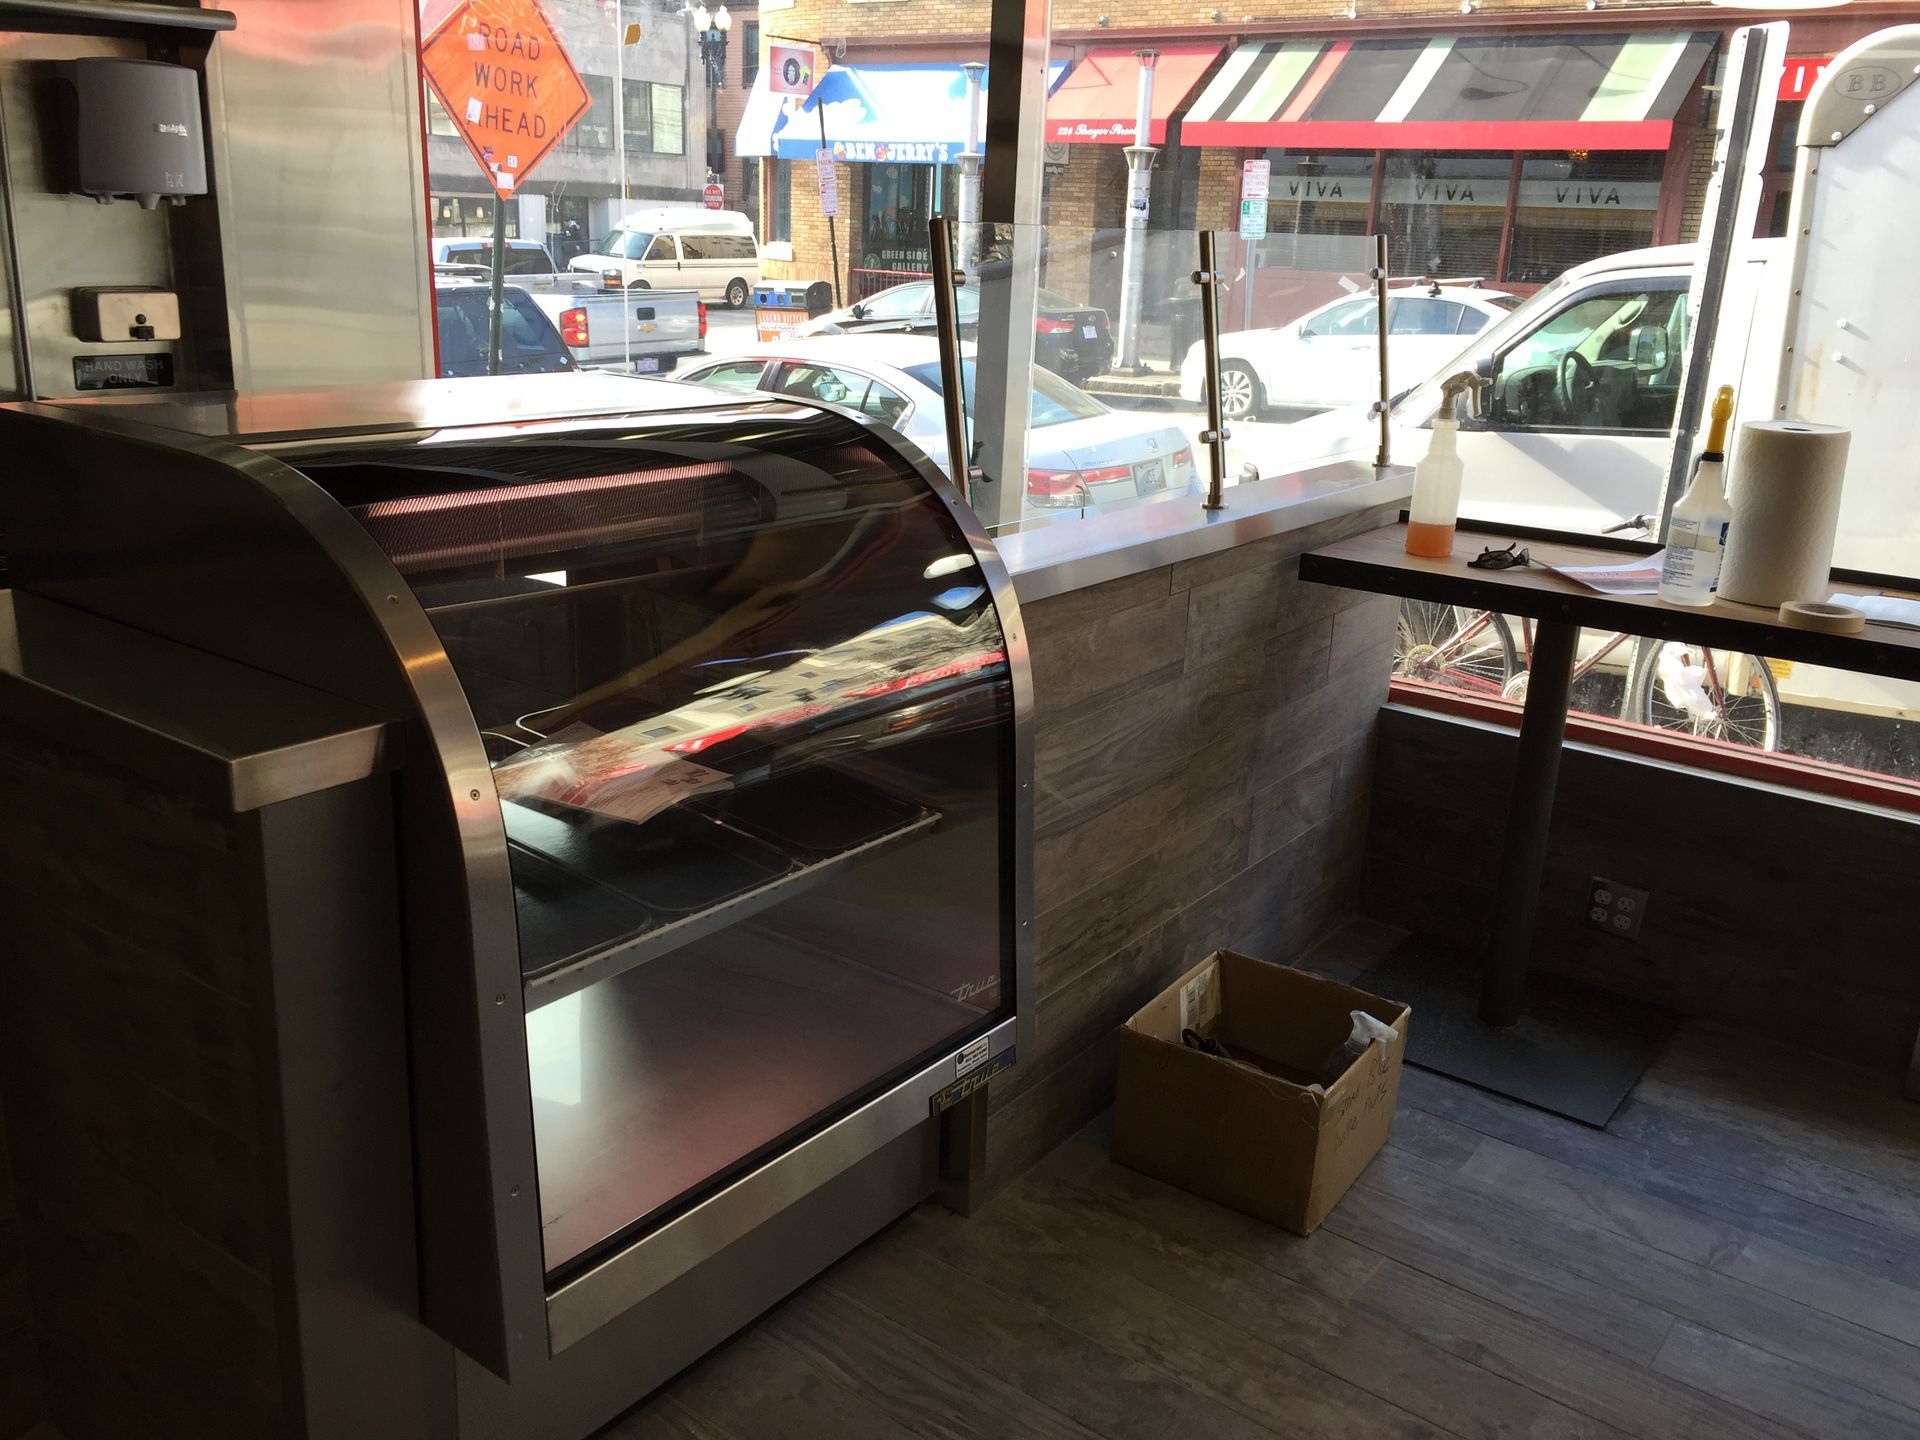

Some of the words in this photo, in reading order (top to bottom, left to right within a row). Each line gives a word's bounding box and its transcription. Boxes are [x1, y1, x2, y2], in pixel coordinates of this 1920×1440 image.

[478, 22, 540, 61] ROAD
[474, 61, 539, 99] WORK
[467, 104, 546, 139] HEAD
[1056, 126, 1073, 136] 224
[1074, 123, 1109, 139] Thayer
[845, 142, 876, 160] BEN
[886, 142, 949, 162] JERRY'S
[1288, 180, 1344, 198] VIVA
[1415, 183, 1476, 202] VIVA
[1555, 186, 1622, 206] VIVA
[881, 249, 905, 260] GREEN
[906, 249, 929, 260] SIDE
[891, 261, 930, 273] GALLERY
[85, 360, 121, 372] HAND
[126, 359, 163, 371] WASH
[108, 372, 145, 384] ONLY
